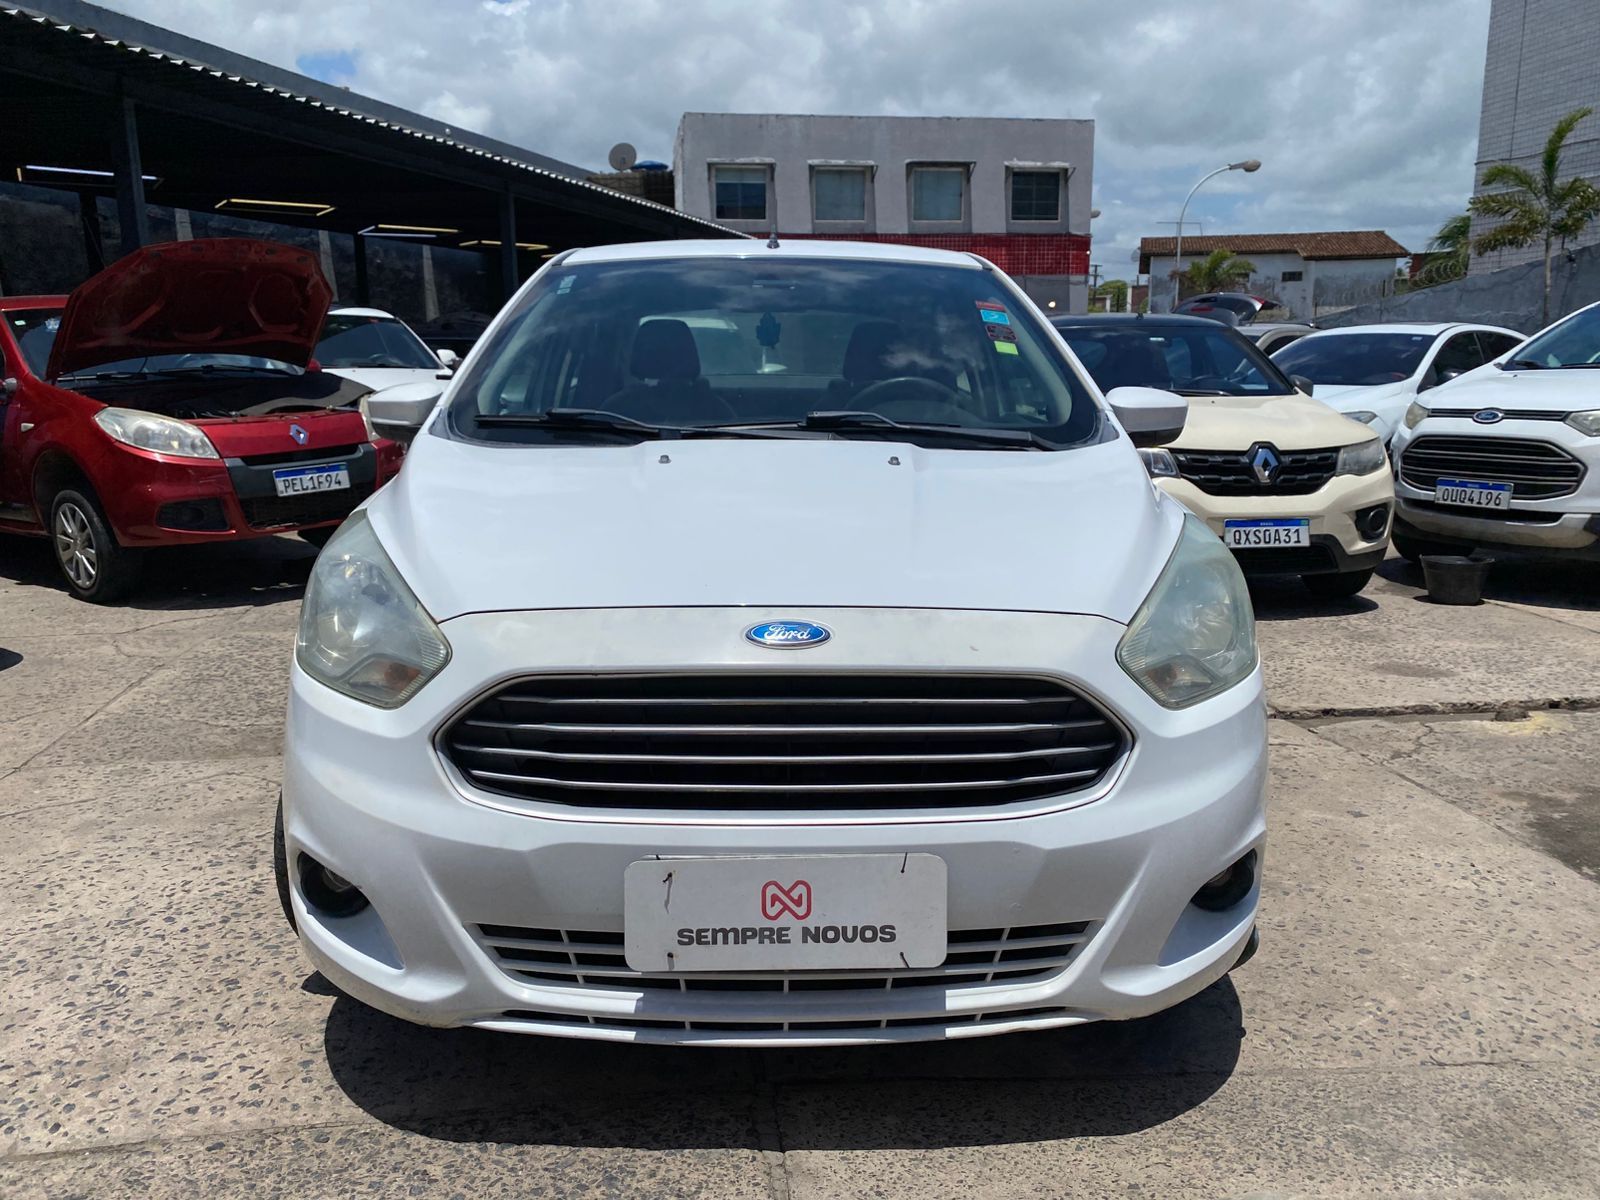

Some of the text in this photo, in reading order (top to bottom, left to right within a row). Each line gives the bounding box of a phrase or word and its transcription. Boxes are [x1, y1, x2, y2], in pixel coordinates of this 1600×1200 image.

[282, 473, 342, 493] PEL1F94
[764, 624, 811, 640] Ford
[677, 927, 791, 946] SEMPRE
